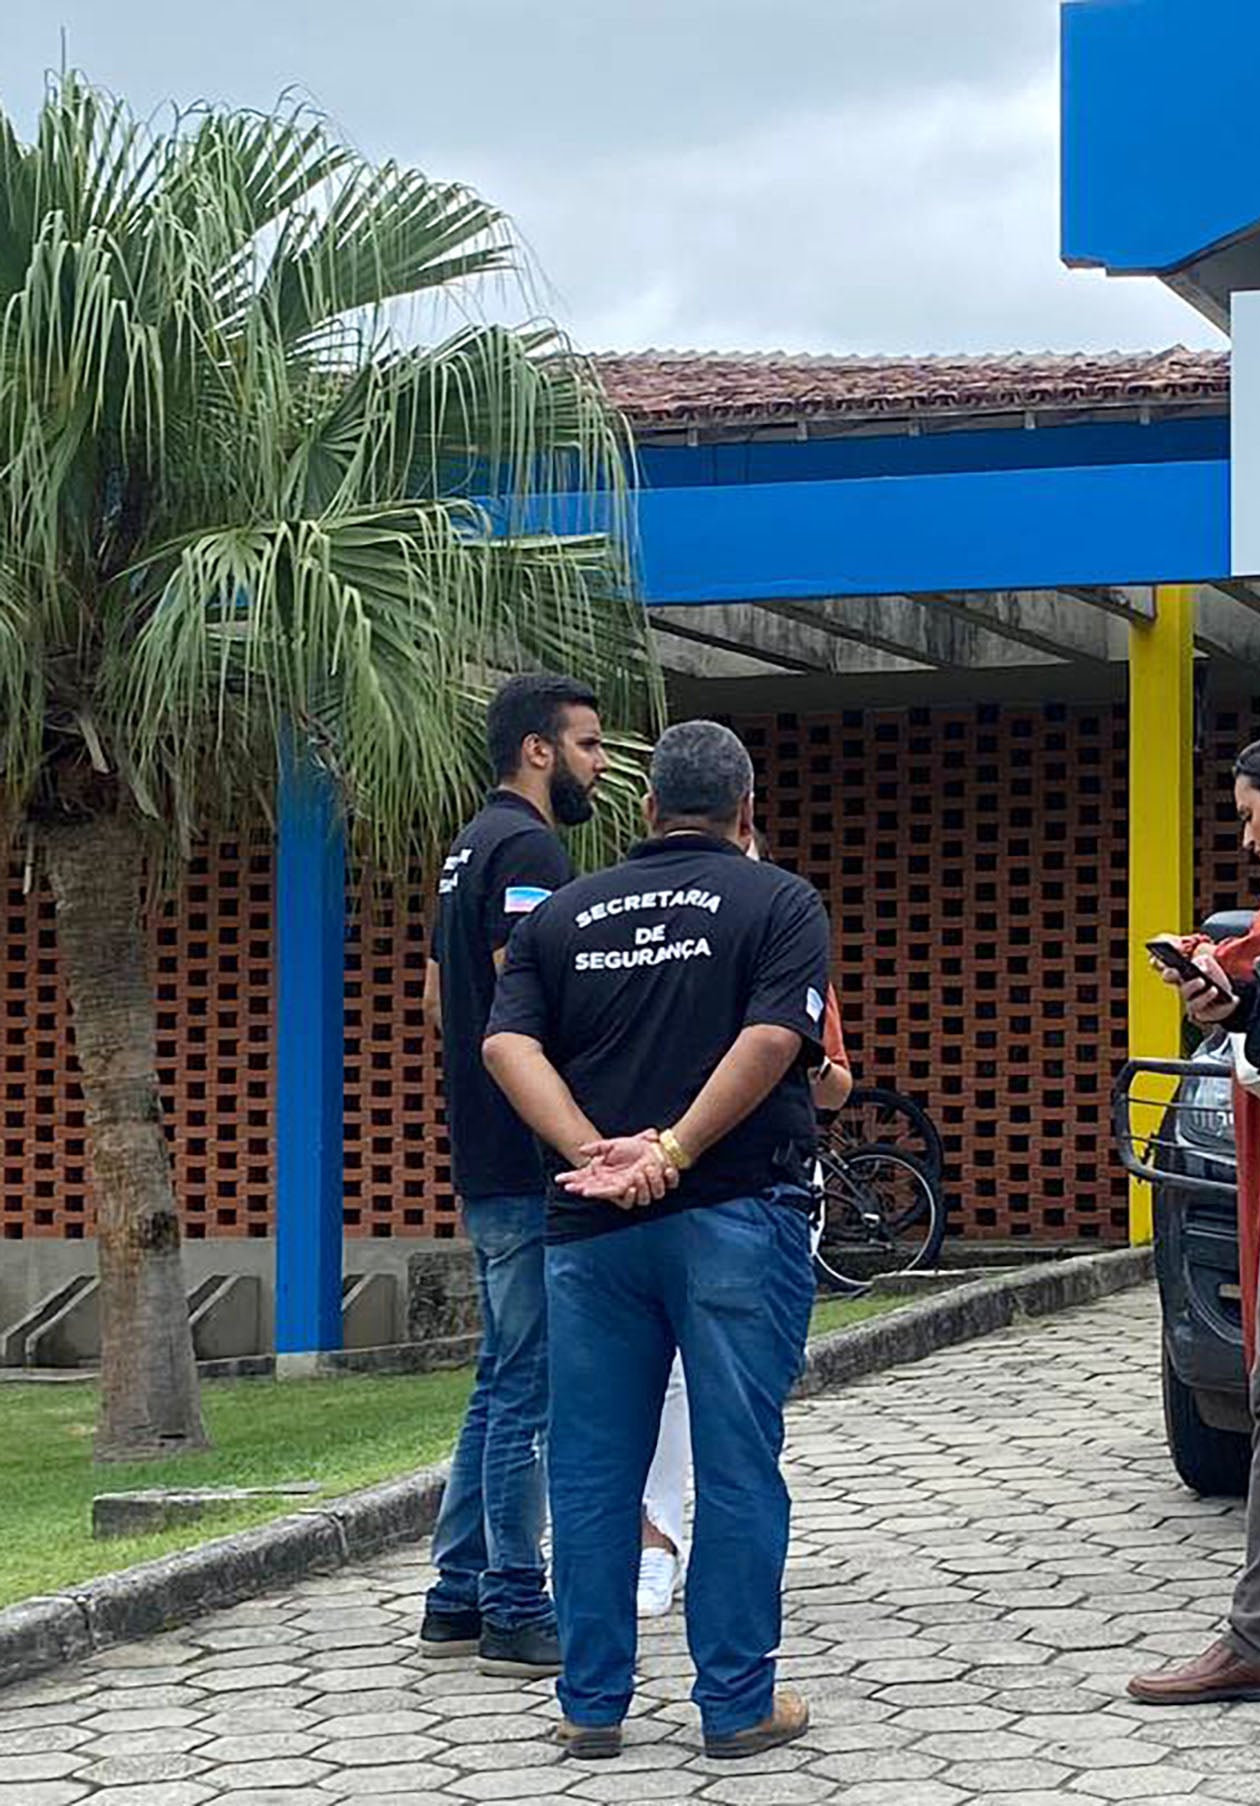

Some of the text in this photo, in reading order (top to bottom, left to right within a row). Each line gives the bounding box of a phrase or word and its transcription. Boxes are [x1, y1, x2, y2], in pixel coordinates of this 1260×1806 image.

[574, 888, 722, 929] SECRETARIA
[634, 923, 667, 946] DE
[574, 937, 713, 971] SEGURANÇA
